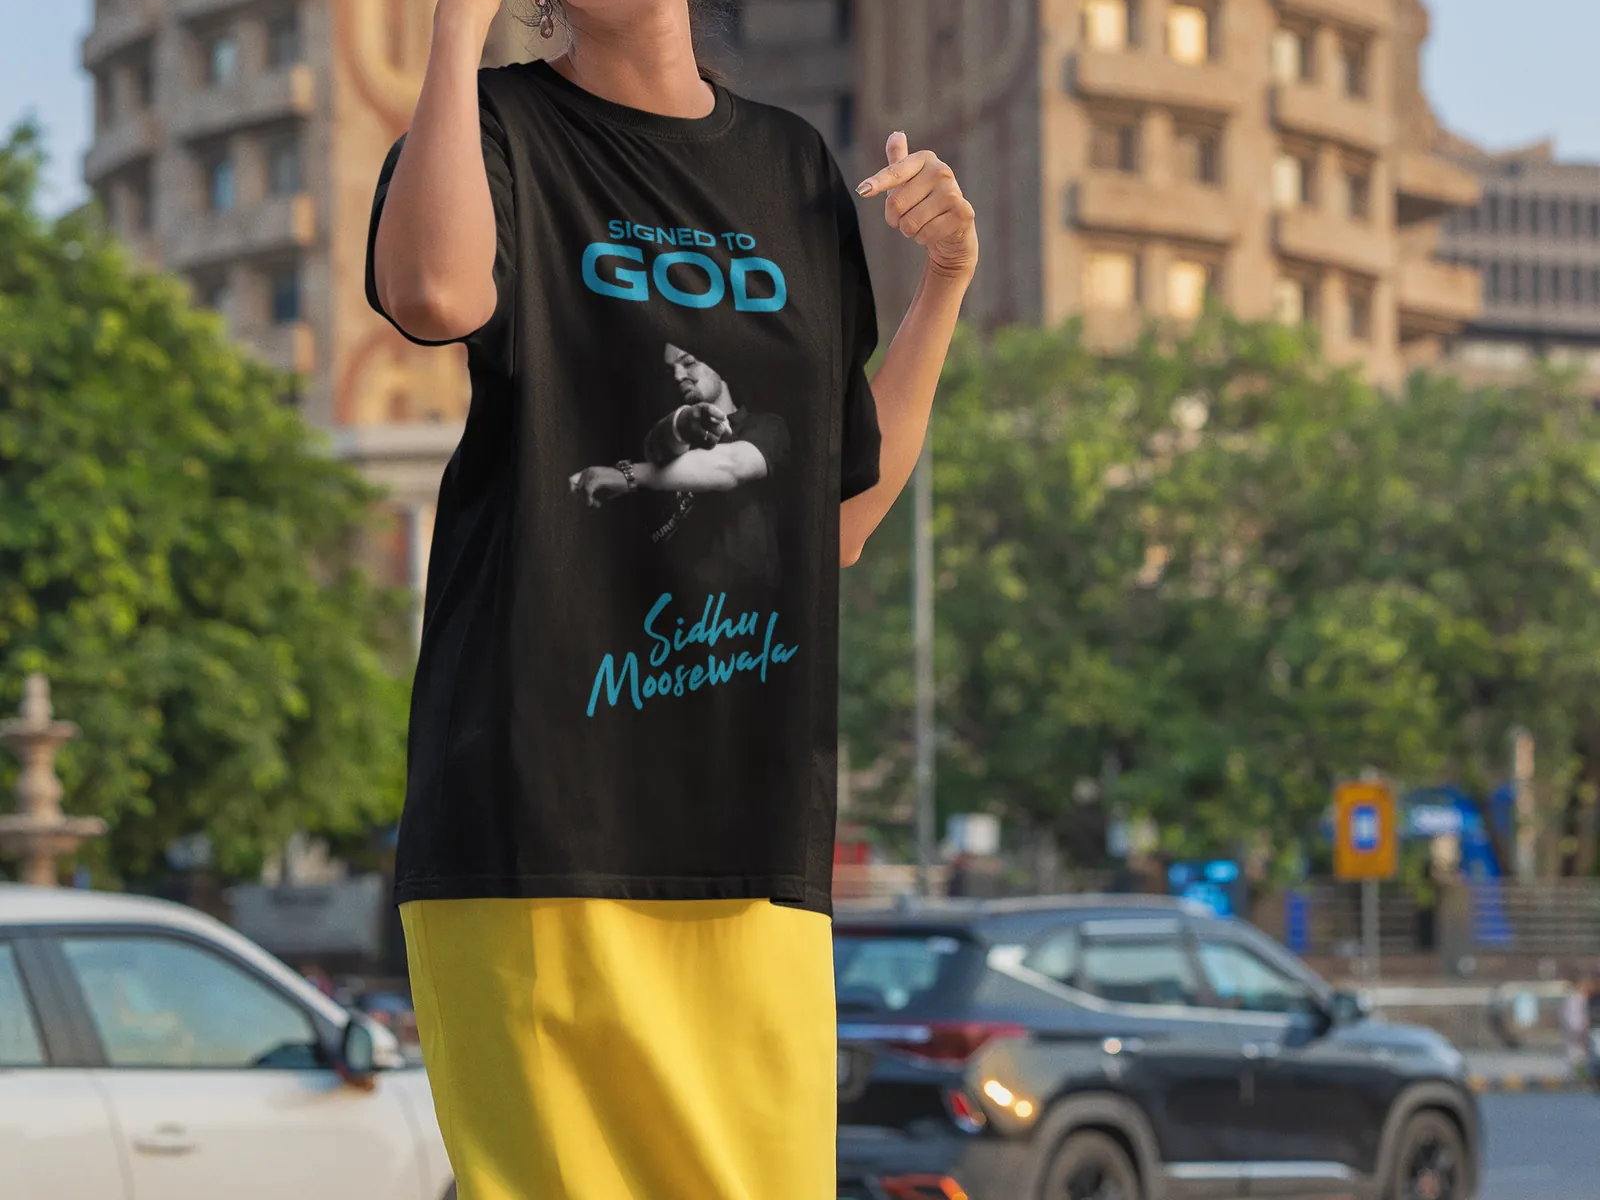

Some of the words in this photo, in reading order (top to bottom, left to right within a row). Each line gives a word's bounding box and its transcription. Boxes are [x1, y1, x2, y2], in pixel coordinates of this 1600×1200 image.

[608, 219, 717, 247] SIGNED
[721, 231, 757, 251] TO
[581, 241, 788, 313] GOD
[586, 611, 799, 718] Moosewala
[643, 591, 759, 667] Sidhu
